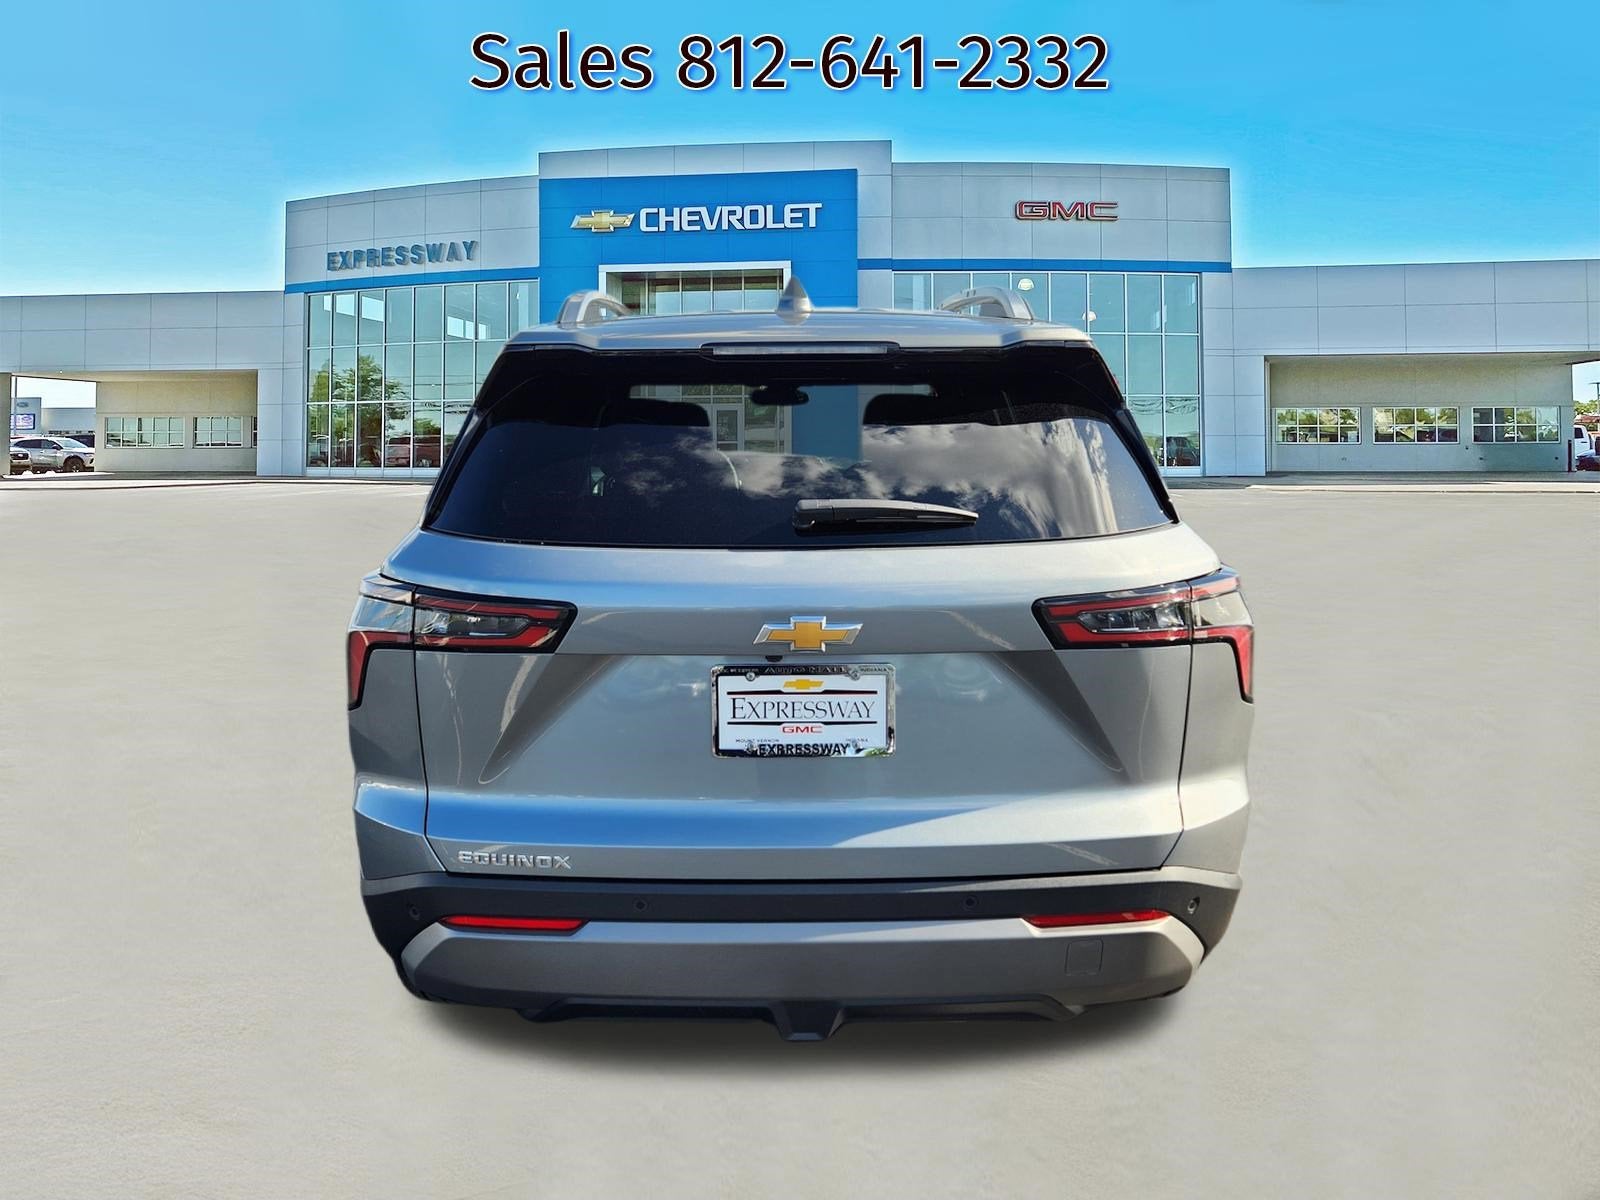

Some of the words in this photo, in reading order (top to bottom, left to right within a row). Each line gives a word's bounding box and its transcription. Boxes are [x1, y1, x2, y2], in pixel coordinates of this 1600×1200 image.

[639, 202, 823, 232] CHEVROLET
[1014, 201, 1119, 221] GMC
[327, 240, 478, 271] EXPRESSWAY
[730, 697, 875, 720] EXPRESSWAY
[782, 725, 823, 734] GMC
[757, 743, 849, 756] EXPRESSWAY
[458, 850, 572, 869] EQUINOX
